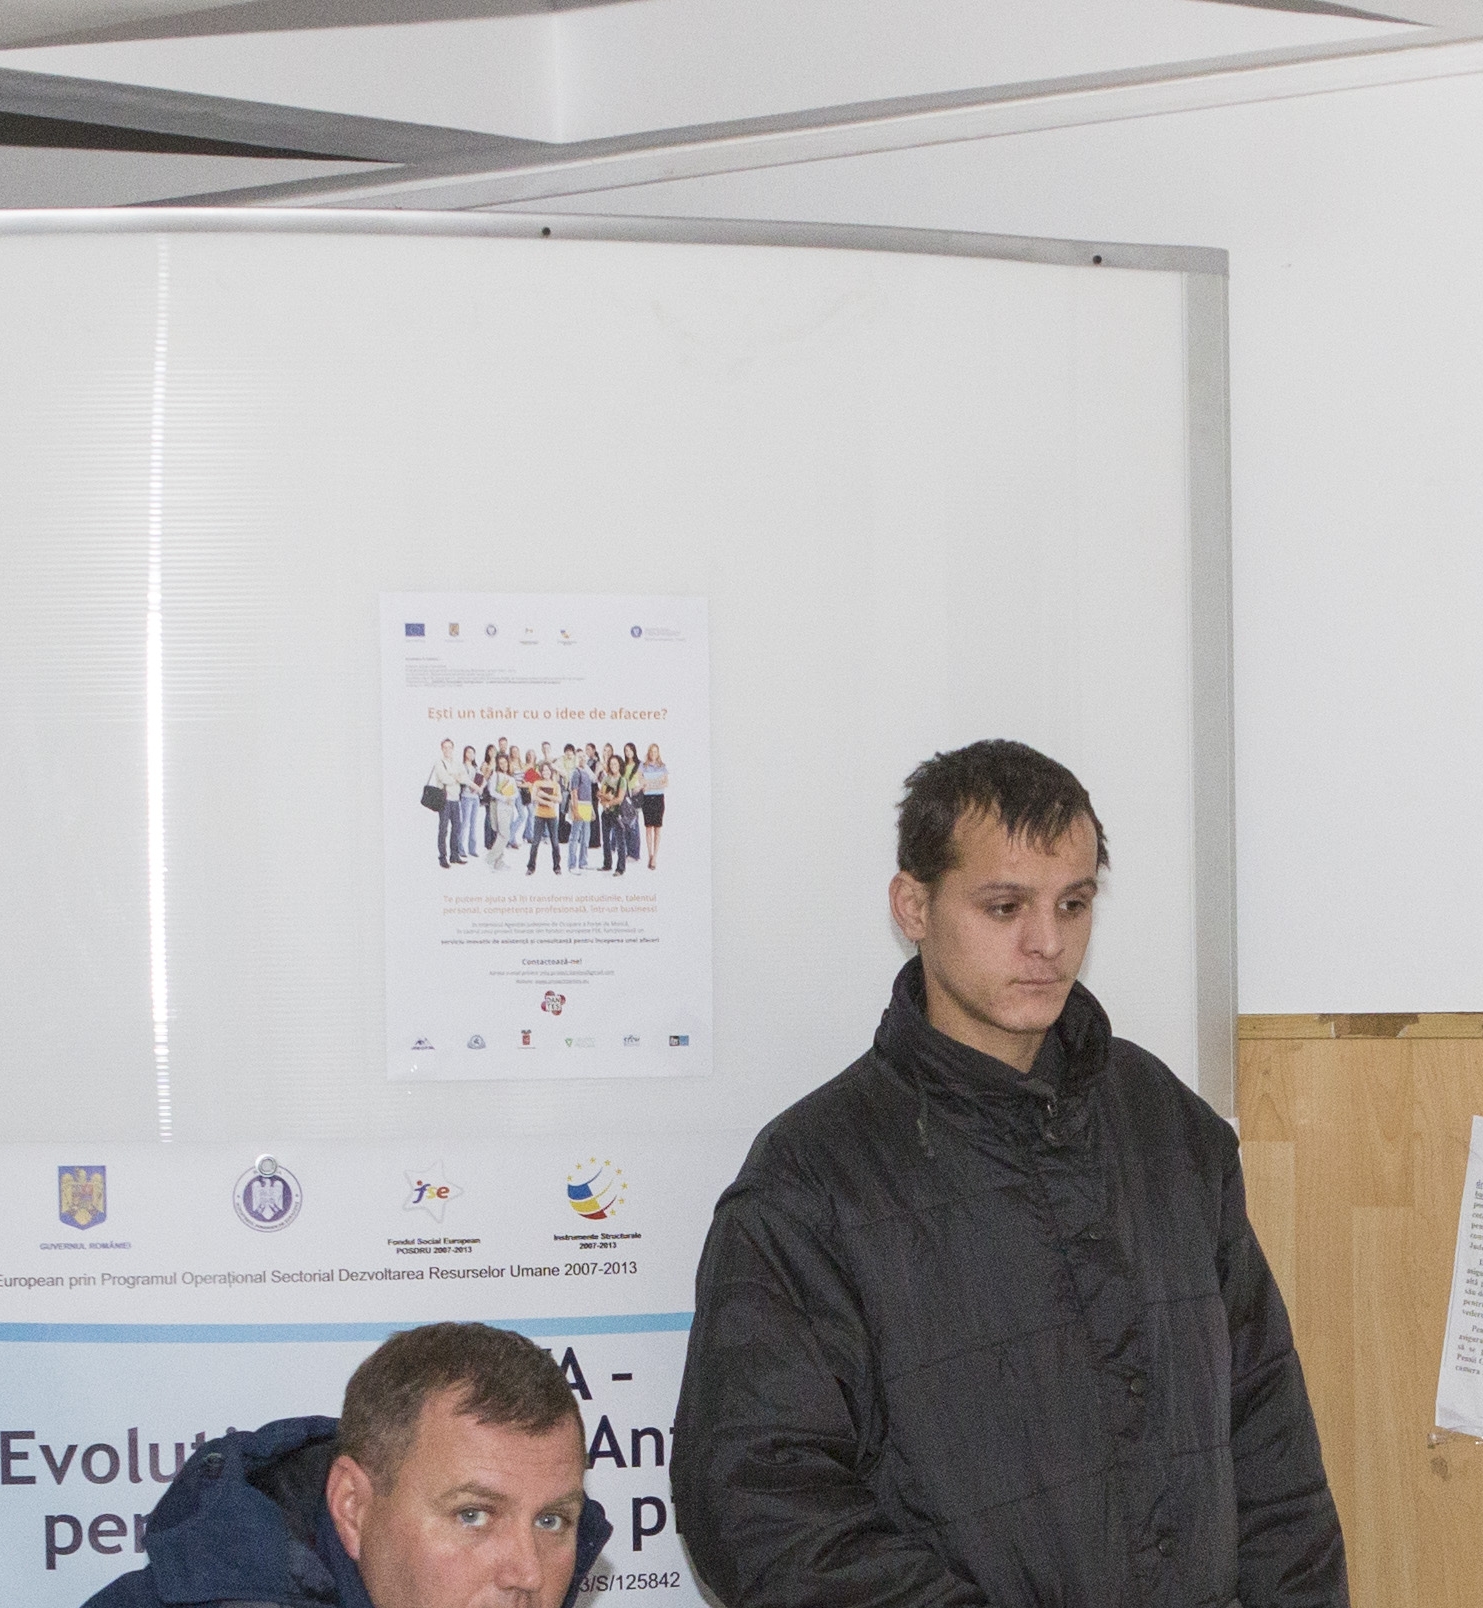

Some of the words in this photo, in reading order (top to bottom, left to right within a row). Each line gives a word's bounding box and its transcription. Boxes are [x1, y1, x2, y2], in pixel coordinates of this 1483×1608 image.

[457, 710, 475, 719] un
[480, 707, 518, 719] tânăr
[523, 710, 539, 720] cu
[543, 710, 552, 719] o
[556, 707, 585, 720] idee
[589, 708, 606, 720] de
[610, 707, 668, 720] afacere?
[522, 958, 582, 966] Contactează-ne!
[579, 1241, 617, 1250] 2007-2013
[69, 1276, 96, 1289] prin
[101, 1273, 176, 1288] Programul
[271, 1269, 334, 1283] Sectorial
[338, 1268, 424, 1282] Dezvoltarea
[429, 1265, 506, 1280] Resurselor
[510, 1264, 560, 1278] Umane
[564, 1261, 638, 1276] 2007-2013
[587, 1414, 676, 1470] An
[0, 1427, 236, 1486] Evolu
